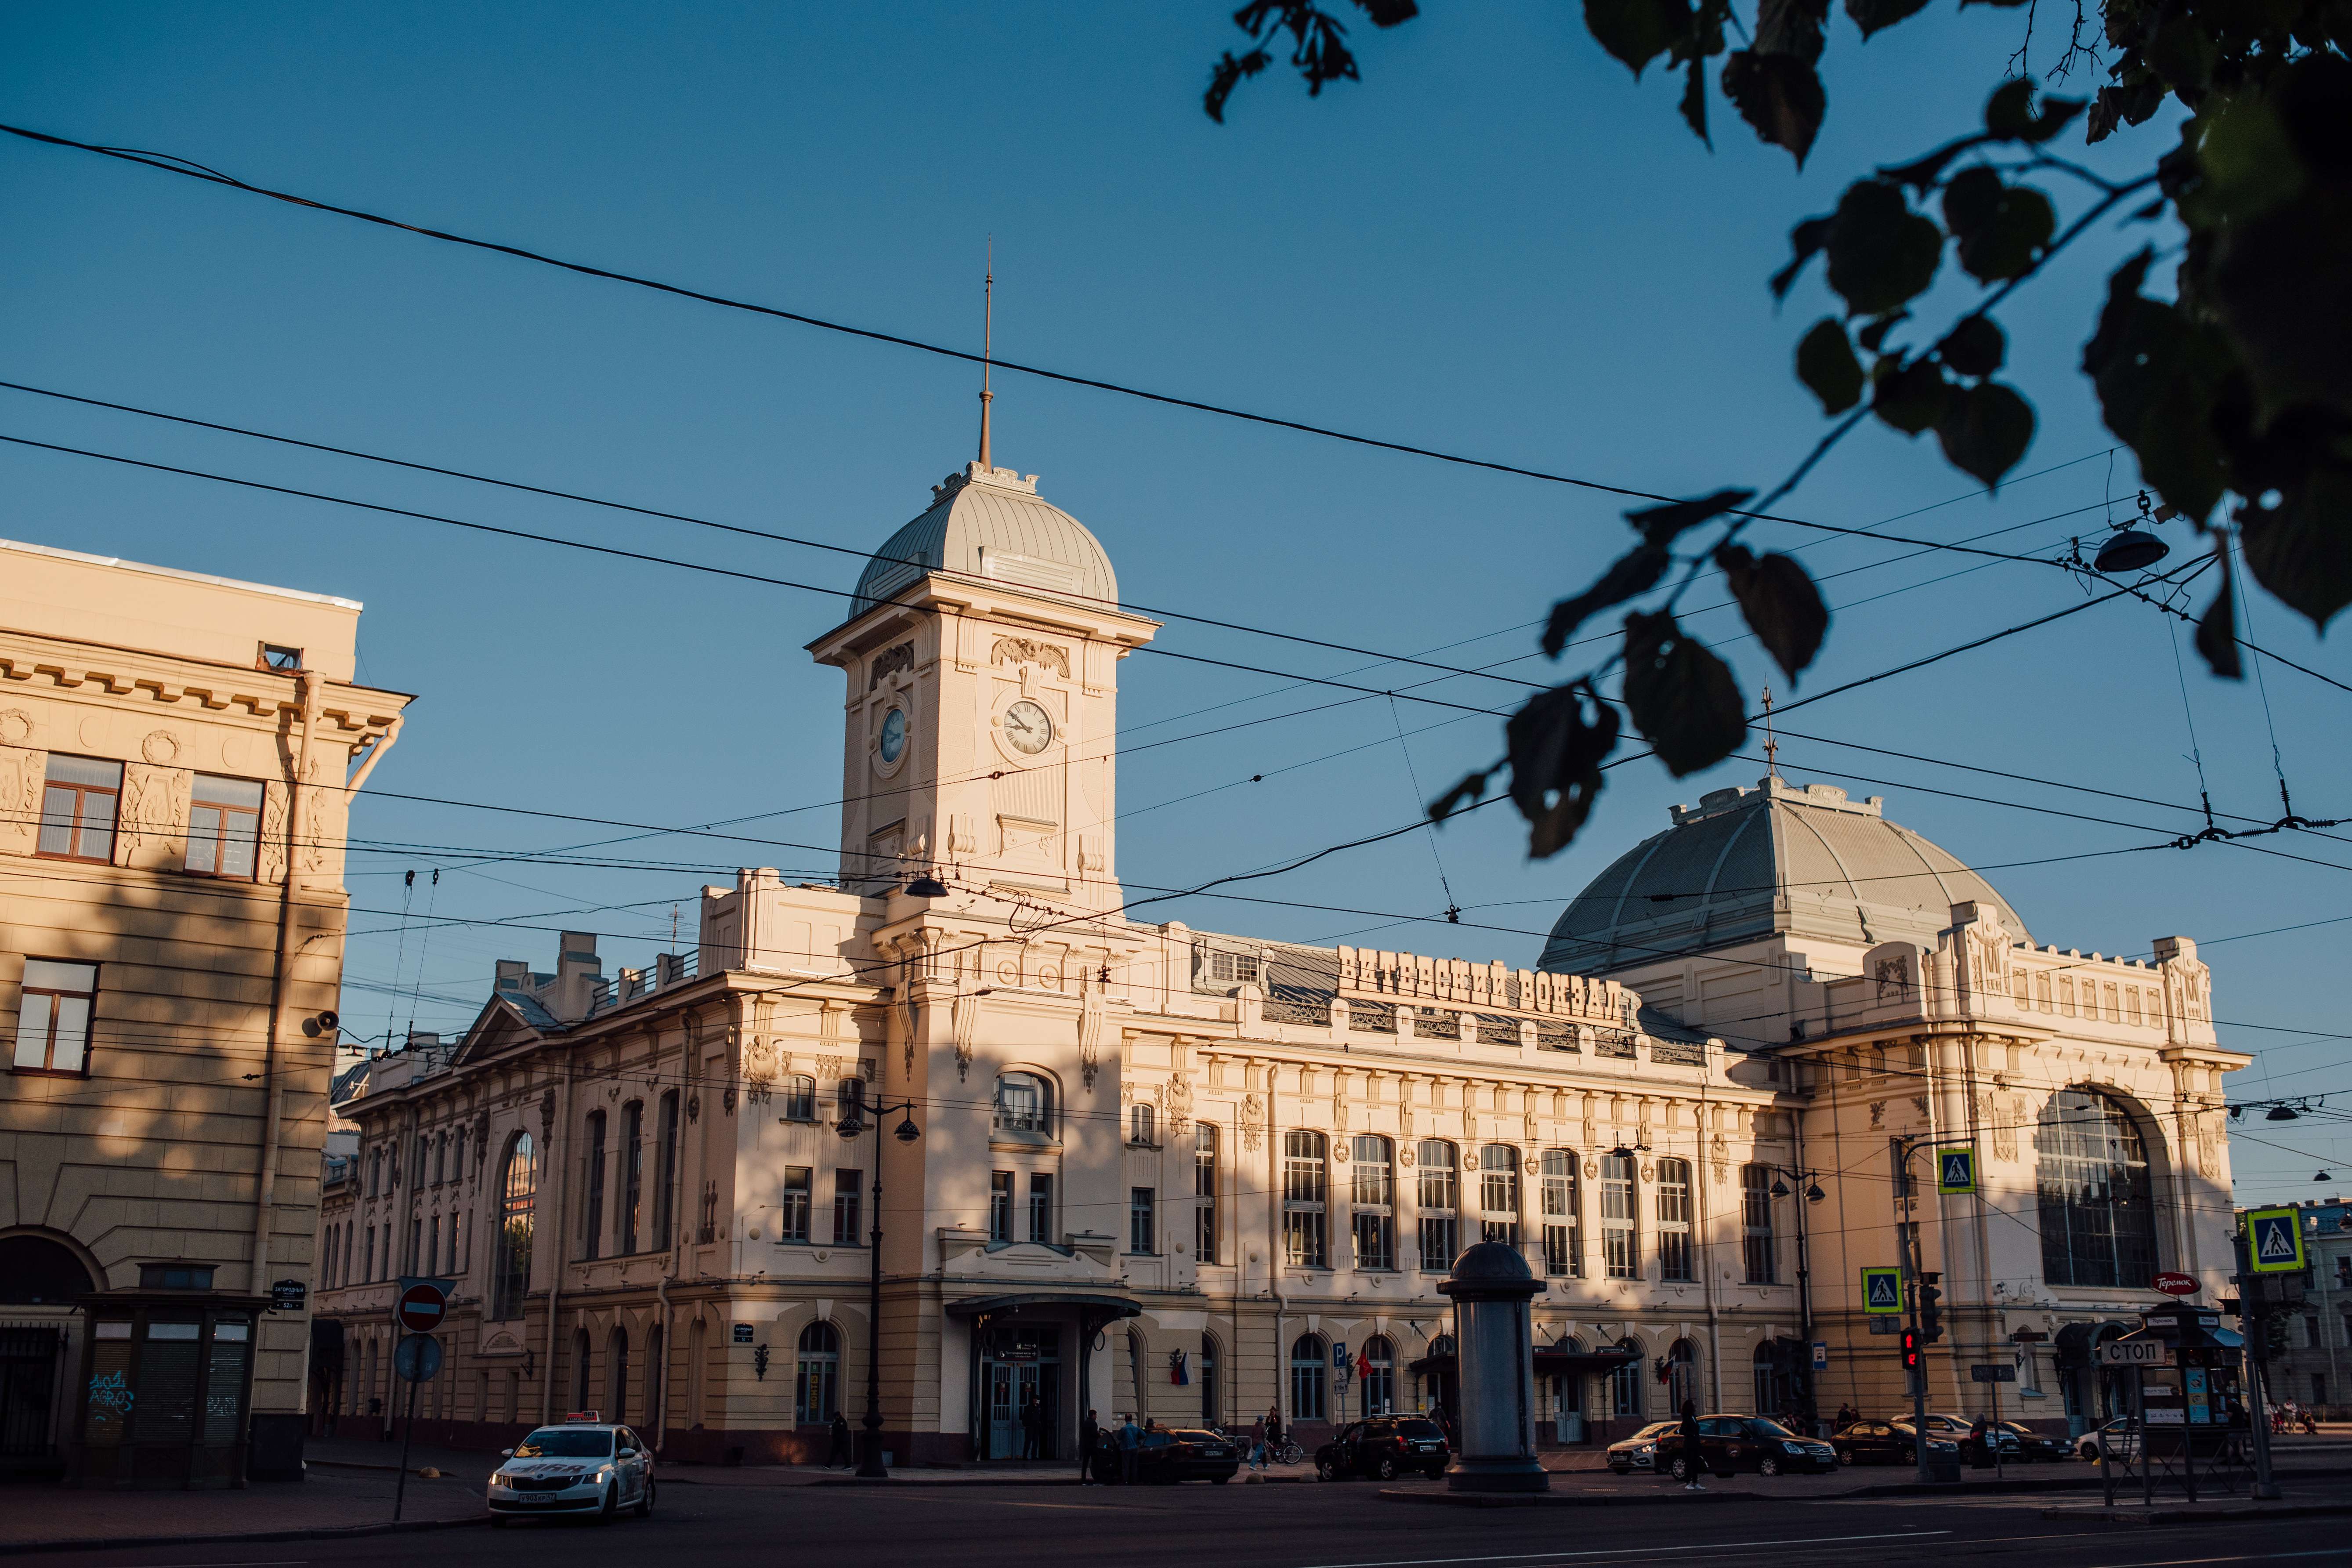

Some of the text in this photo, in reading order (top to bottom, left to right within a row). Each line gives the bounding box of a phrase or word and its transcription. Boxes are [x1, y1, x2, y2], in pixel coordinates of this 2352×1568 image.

[1337, 945, 1621, 1020] ВИТЕБСКИЙ ВОКЗАЛ
[2157, 1277, 2192, 1290] Теремок
[1336, 1345, 1343, 1365] P
[2110, 1344, 2156, 1360] СТОП
